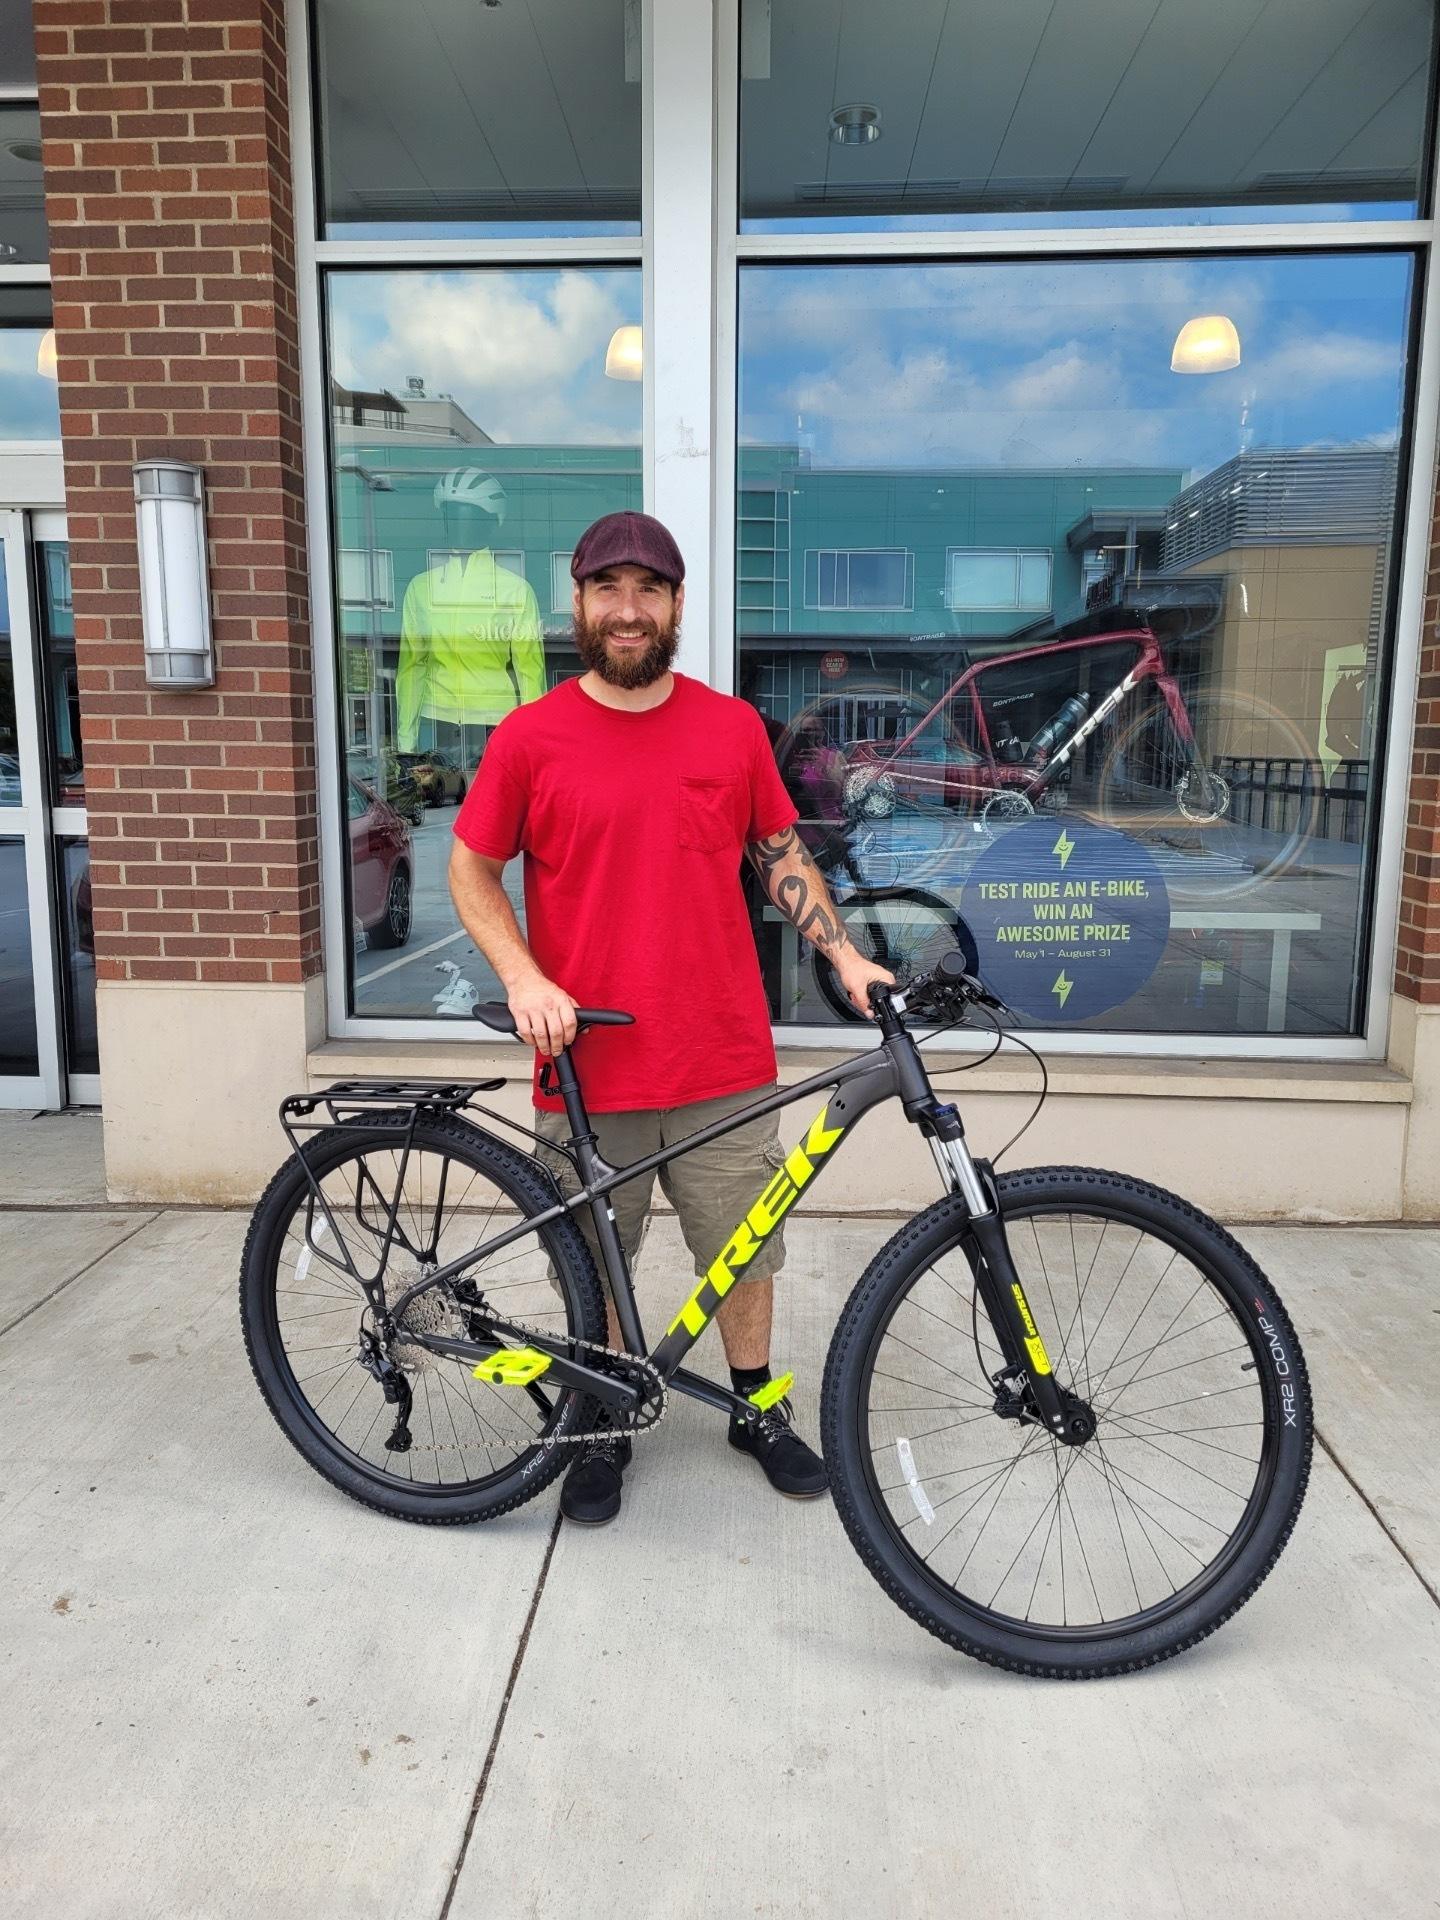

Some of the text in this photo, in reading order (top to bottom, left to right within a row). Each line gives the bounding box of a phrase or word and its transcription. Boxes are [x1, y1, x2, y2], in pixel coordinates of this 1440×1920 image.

[1051, 671, 1139, 764] TREK
[979, 880, 1150, 899] TEST RIDE AN E-BIKE,
[1033, 903, 1093, 920] WIN AN
[996, 924, 1131, 942] AWESOME PRIZE
[1015, 950, 1038, 960] May
[1058, 949, 1097, 960] August
[1099, 949, 1111, 958] 31
[667, 1104, 845, 1337] TREK
[1258, 1317, 1297, 1428] XR2 COMP
[521, 1450, 545, 1479] XR2
